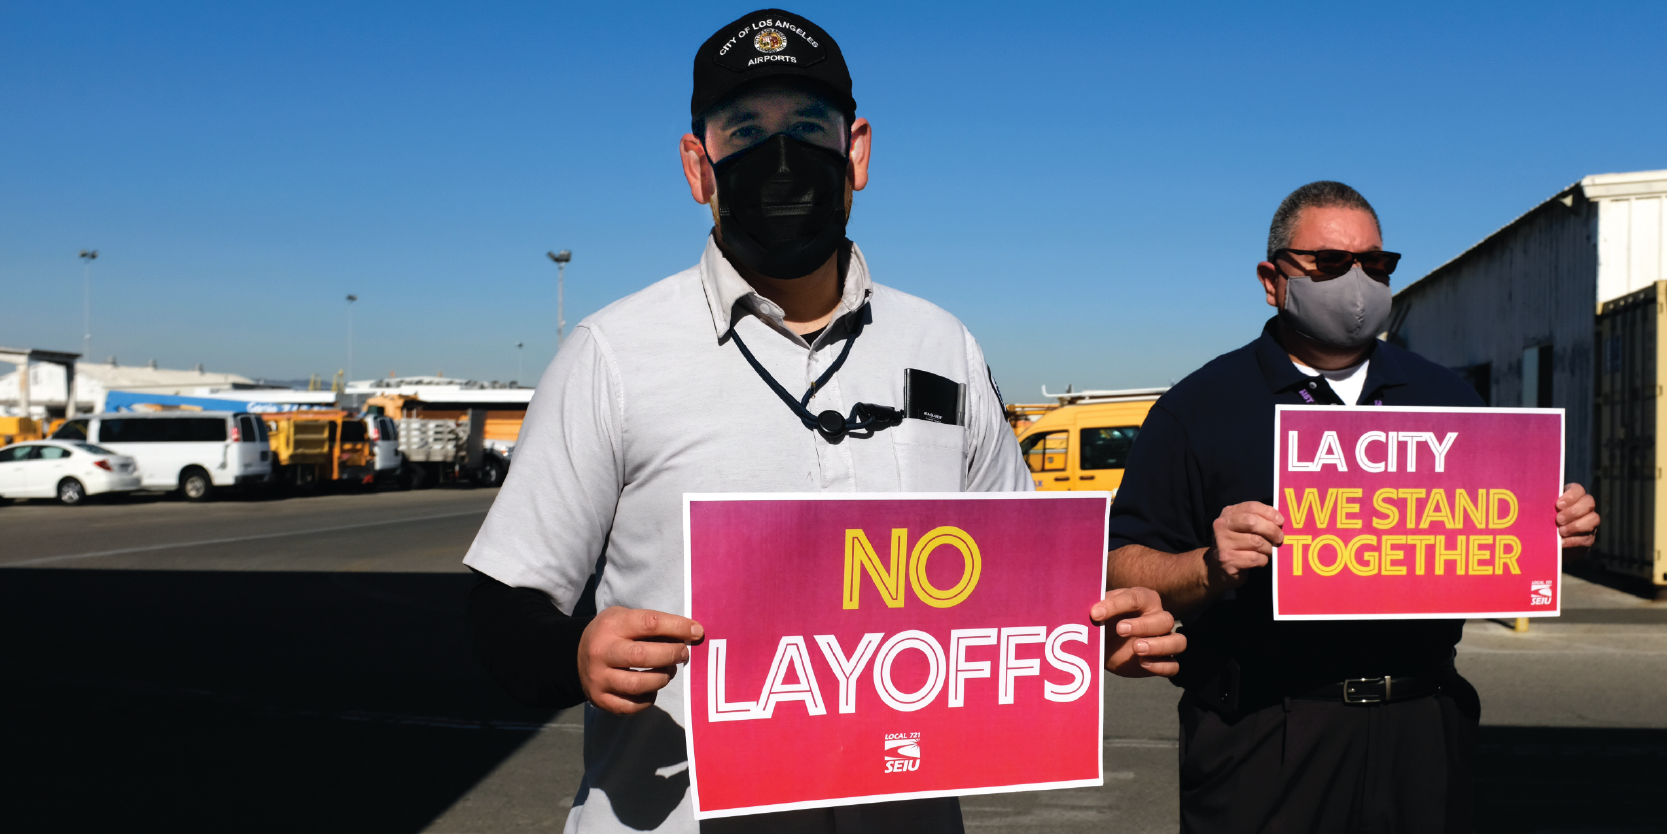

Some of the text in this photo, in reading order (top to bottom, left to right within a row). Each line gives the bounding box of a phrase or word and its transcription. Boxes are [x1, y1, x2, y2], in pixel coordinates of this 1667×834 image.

[719, 37, 737, 56] CITY
[738, 26, 750, 38] OF
[752, 19, 773, 30] LOS
[775, 20, 819, 48] ANGELES
[747, 55, 797, 67] AIRPORTS
[1287, 430, 1459, 473] LA CITY
[1285, 488, 1519, 530] WE STAND
[843, 526, 981, 610] NO
[1285, 534, 1521, 576] TOGETHER
[1531, 597, 1552, 605] SEIU
[707, 624, 1092, 723] LAYOFFS
[884, 759, 920, 773] SEIU
